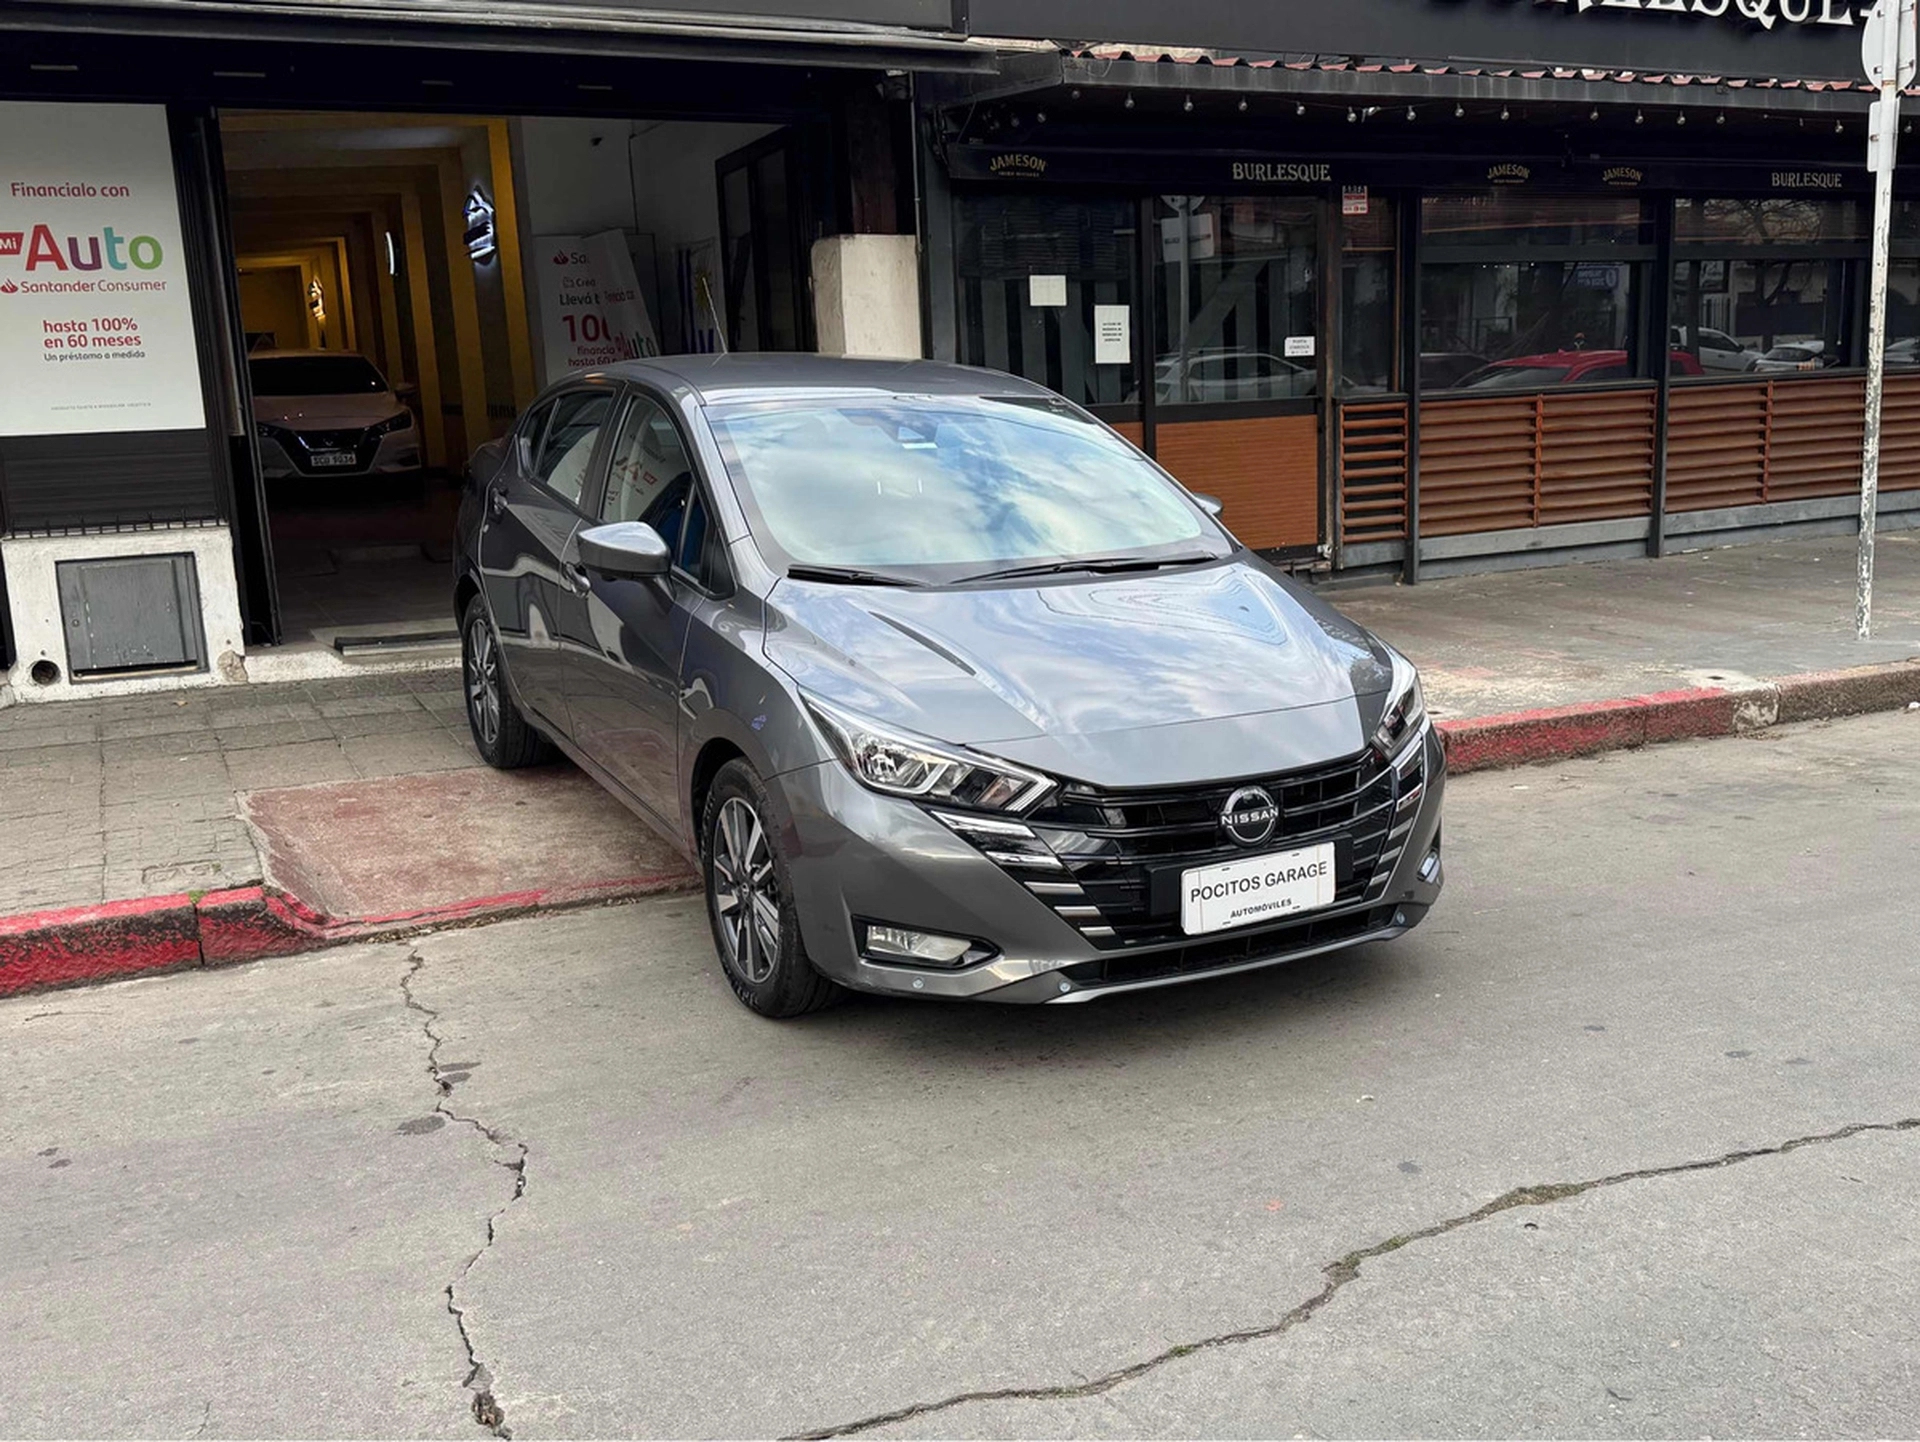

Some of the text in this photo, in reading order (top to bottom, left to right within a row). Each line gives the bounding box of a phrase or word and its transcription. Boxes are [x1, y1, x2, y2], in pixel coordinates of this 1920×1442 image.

[990, 153, 1047, 172] JAMESON
[1487, 163, 1530, 179] JAMESON
[1232, 162, 1332, 183] BURLESQUE
[1602, 166, 1643, 182] JAMESON
[1771, 172, 1843, 189] BURLESQUE
[11, 182, 130, 198] Financialo con
[25, 223, 164, 272] Auto
[20, 279, 168, 294] Santander Consumer
[43, 317, 138, 334] hasta 100%
[44, 333, 142, 349] en 60 meses
[44, 353, 57, 362] Un
[112, 349, 145, 360] medida
[1221, 806, 1279, 825] NISSAN
[1190, 861, 1328, 903] POCITOS GARAGE
